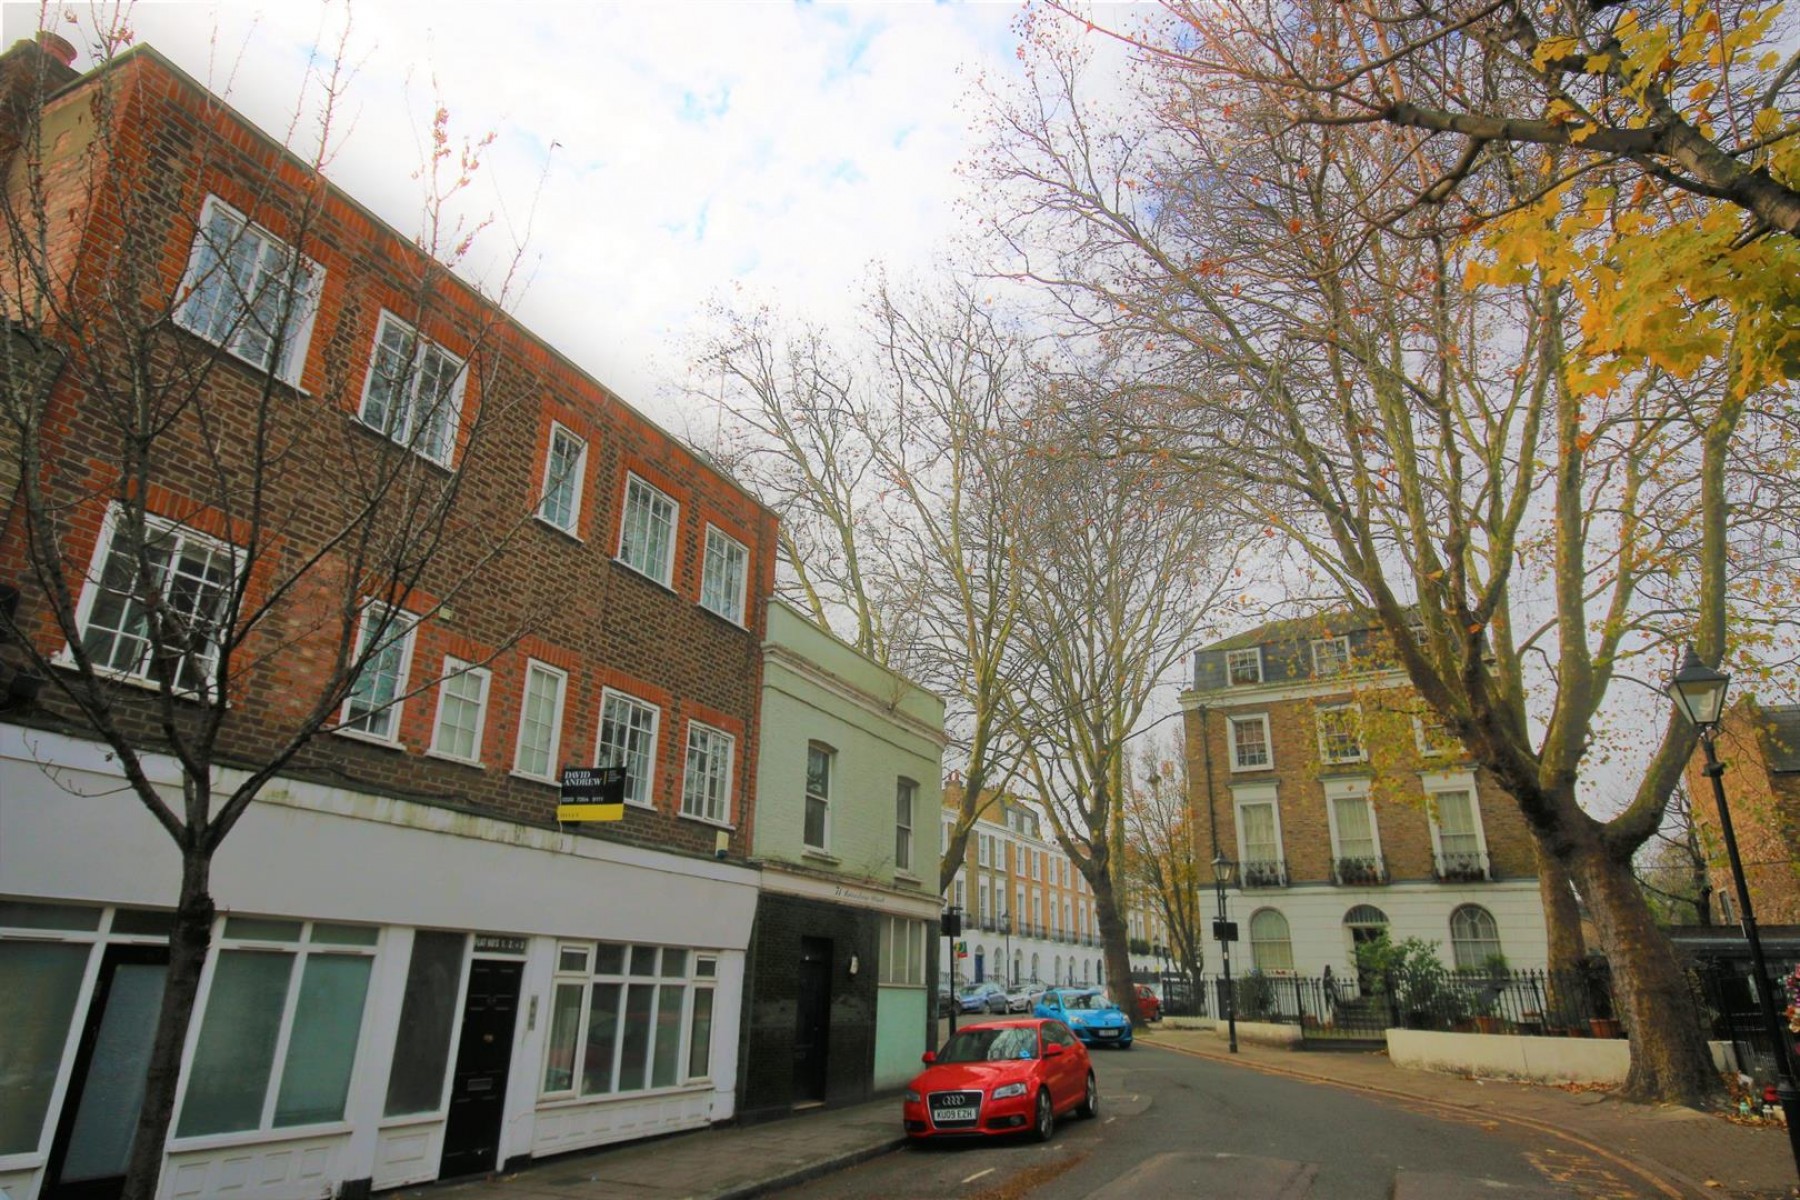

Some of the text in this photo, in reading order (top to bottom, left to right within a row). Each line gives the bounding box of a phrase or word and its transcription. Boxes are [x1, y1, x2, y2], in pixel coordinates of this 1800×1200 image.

[564, 770, 591, 778] DAVID
[564, 778, 603, 787] ANDREW
[937, 1109, 973, 1120] KU09 EZH
